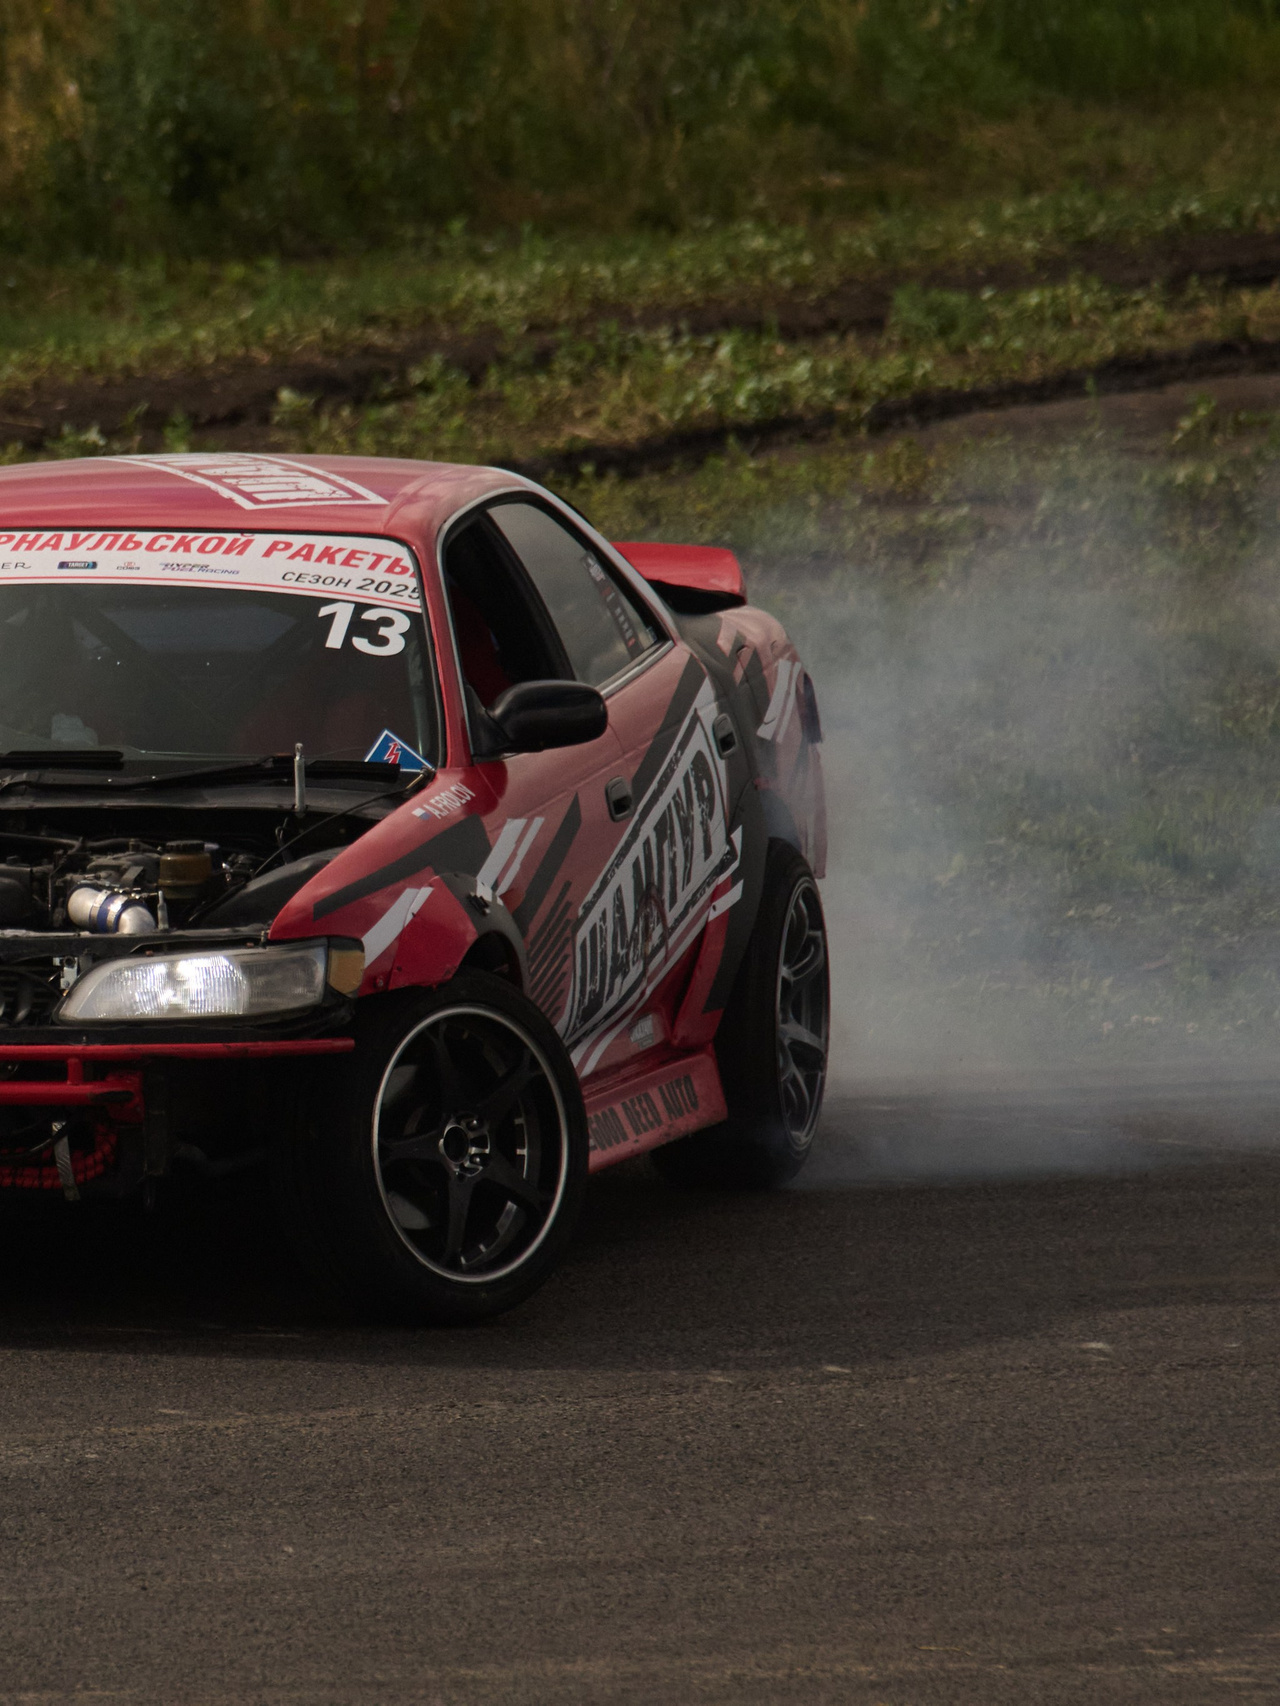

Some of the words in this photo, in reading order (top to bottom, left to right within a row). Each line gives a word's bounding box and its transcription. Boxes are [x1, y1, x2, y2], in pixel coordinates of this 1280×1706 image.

[281, 571, 352, 588] СЕЗОН
[356, 577, 420, 599] 2025
[318, 601, 411, 656] 13
[658, 1075, 699, 1120] AUTO
